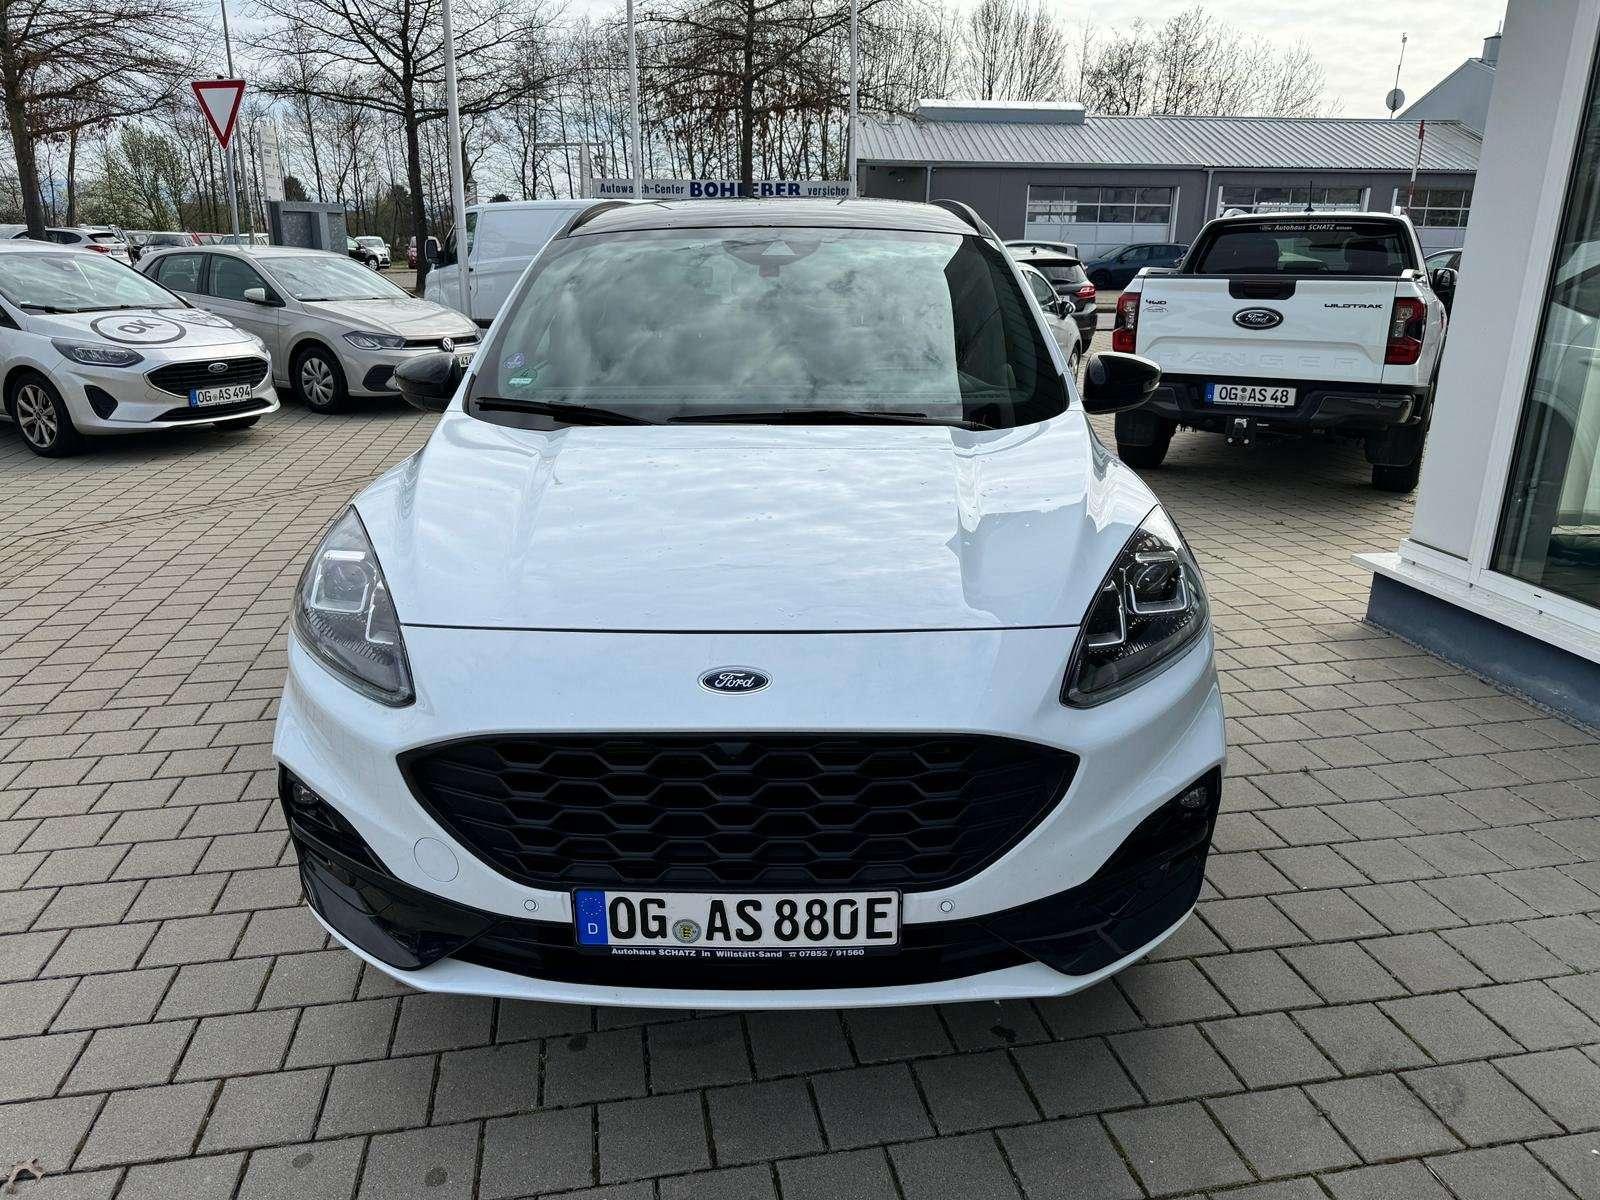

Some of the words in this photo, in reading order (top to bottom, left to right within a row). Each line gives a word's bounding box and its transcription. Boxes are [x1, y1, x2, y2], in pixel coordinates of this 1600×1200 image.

[600, 183, 684, 195] Autowah-Center
[117, 319, 162, 334] OK
[198, 391, 212, 403] OG
[218, 388, 231, 401] AS
[233, 386, 251, 399] 494
[1219, 386, 1239, 401] OG
[1247, 387, 1268, 402] AS
[1270, 389, 1289, 404] 48
[714, 672, 755, 688] Ford
[608, 896, 667, 940] OG
[587, 922, 598, 935] D
[611, 948, 657, 956] Autohaus
[658, 949, 697, 957] SCHATZ
[799, 949, 828, 958] 07852
[836, 949, 865, 957] 91560
